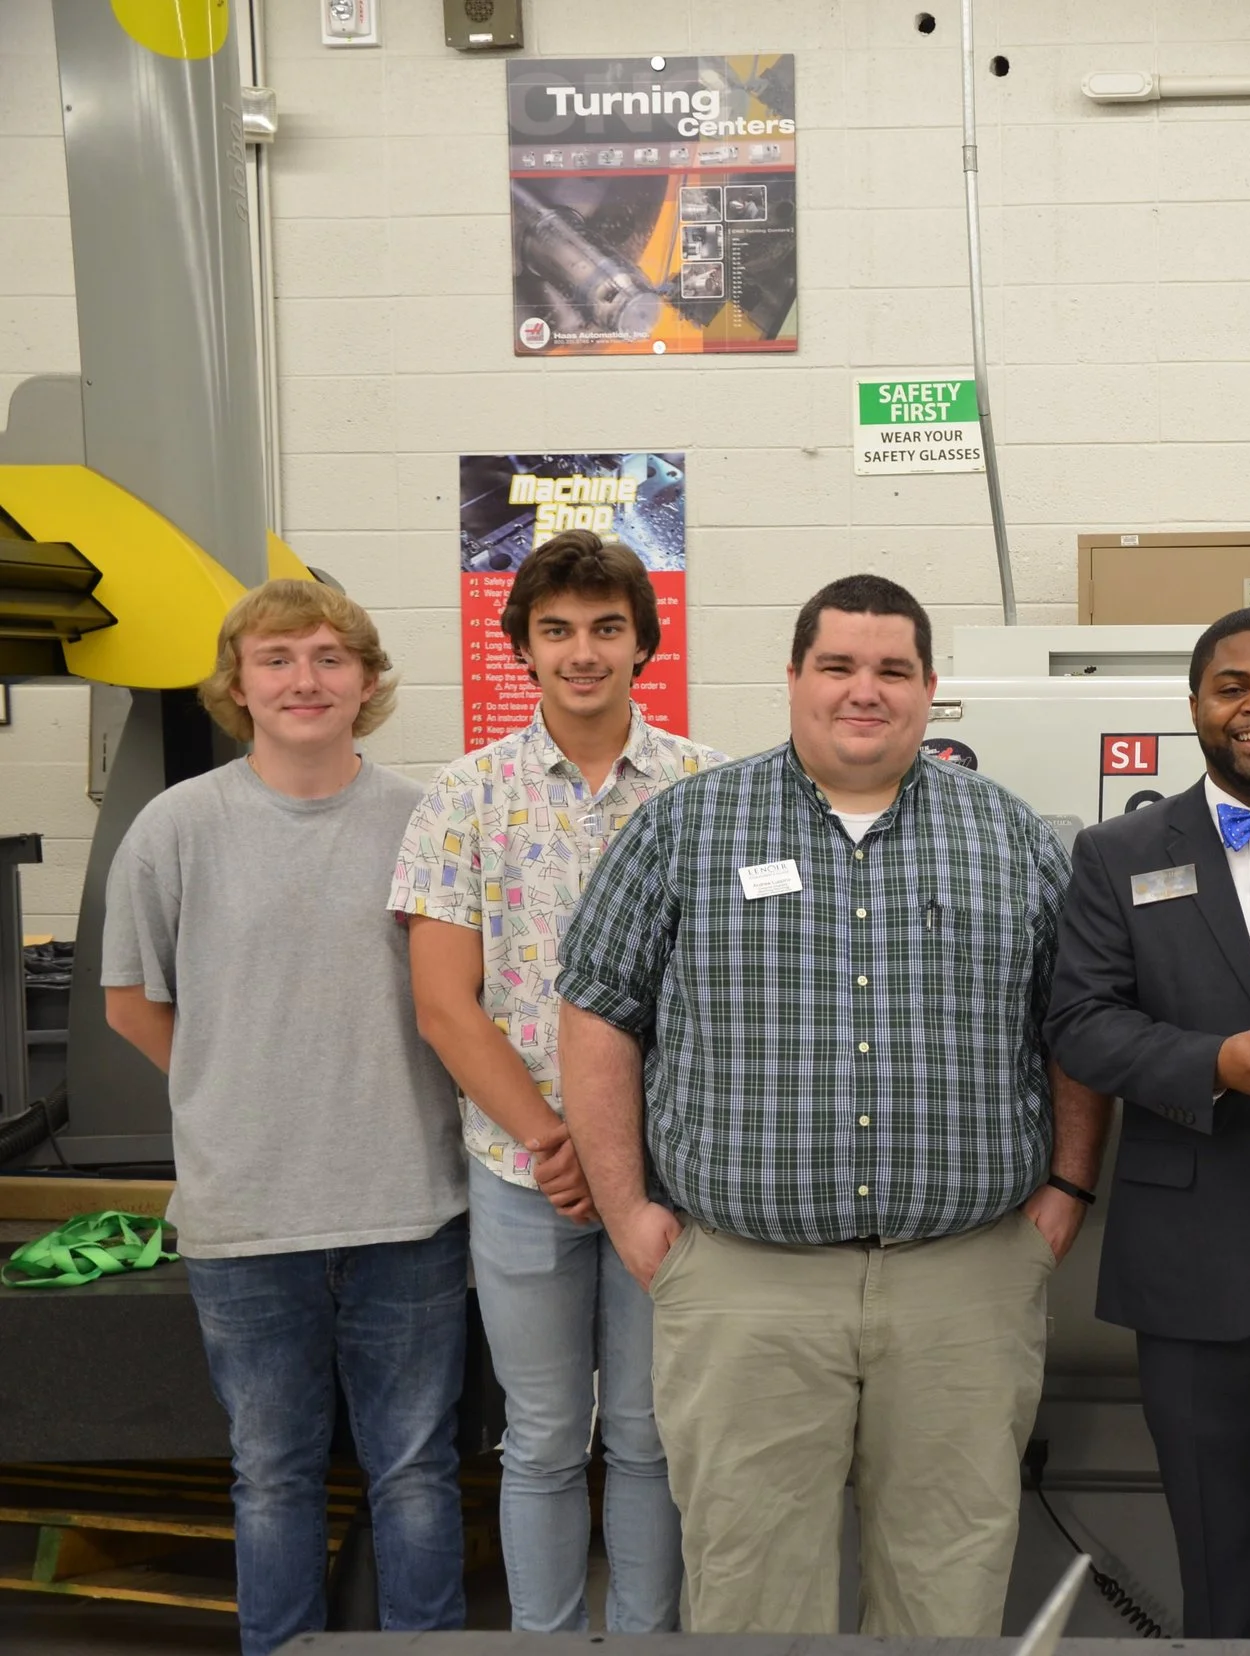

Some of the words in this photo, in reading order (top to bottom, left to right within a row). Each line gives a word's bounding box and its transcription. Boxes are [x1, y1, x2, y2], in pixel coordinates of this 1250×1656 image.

[546, 84, 720, 121] Turning
[677, 116, 795, 137] Centers
[878, 382, 961, 403] SAFETY
[890, 402, 951, 422] FIRST
[880, 431, 921, 443] WEAR
[924, 430, 963, 442] YOUR
[864, 450, 916, 463] SAFETY
[919, 448, 980, 461] GLASSES
[509, 474, 637, 504] Machine
[536, 502, 614, 534] Shop
[483, 577, 506, 587] Safety
[483, 589, 503, 597] Wear
[484, 642, 503, 651] Long
[471, 653, 481, 661] #5
[485, 653, 511, 663] Jewelry
[656, 652, 672, 662] prior
[485, 673, 504, 682] Keep
[504, 673, 516, 681] the
[504, 683, 518, 691] Any
[640, 681, 659, 690] order
[499, 692, 525, 700] prevent
[486, 702, 497, 710] Do
[509, 702, 528, 710] leave
[497, 714, 529, 722] instructor
[486, 726, 505, 735] Keep
[1111, 741, 1149, 770] SL
[747, 863, 787, 876] LENOIR
